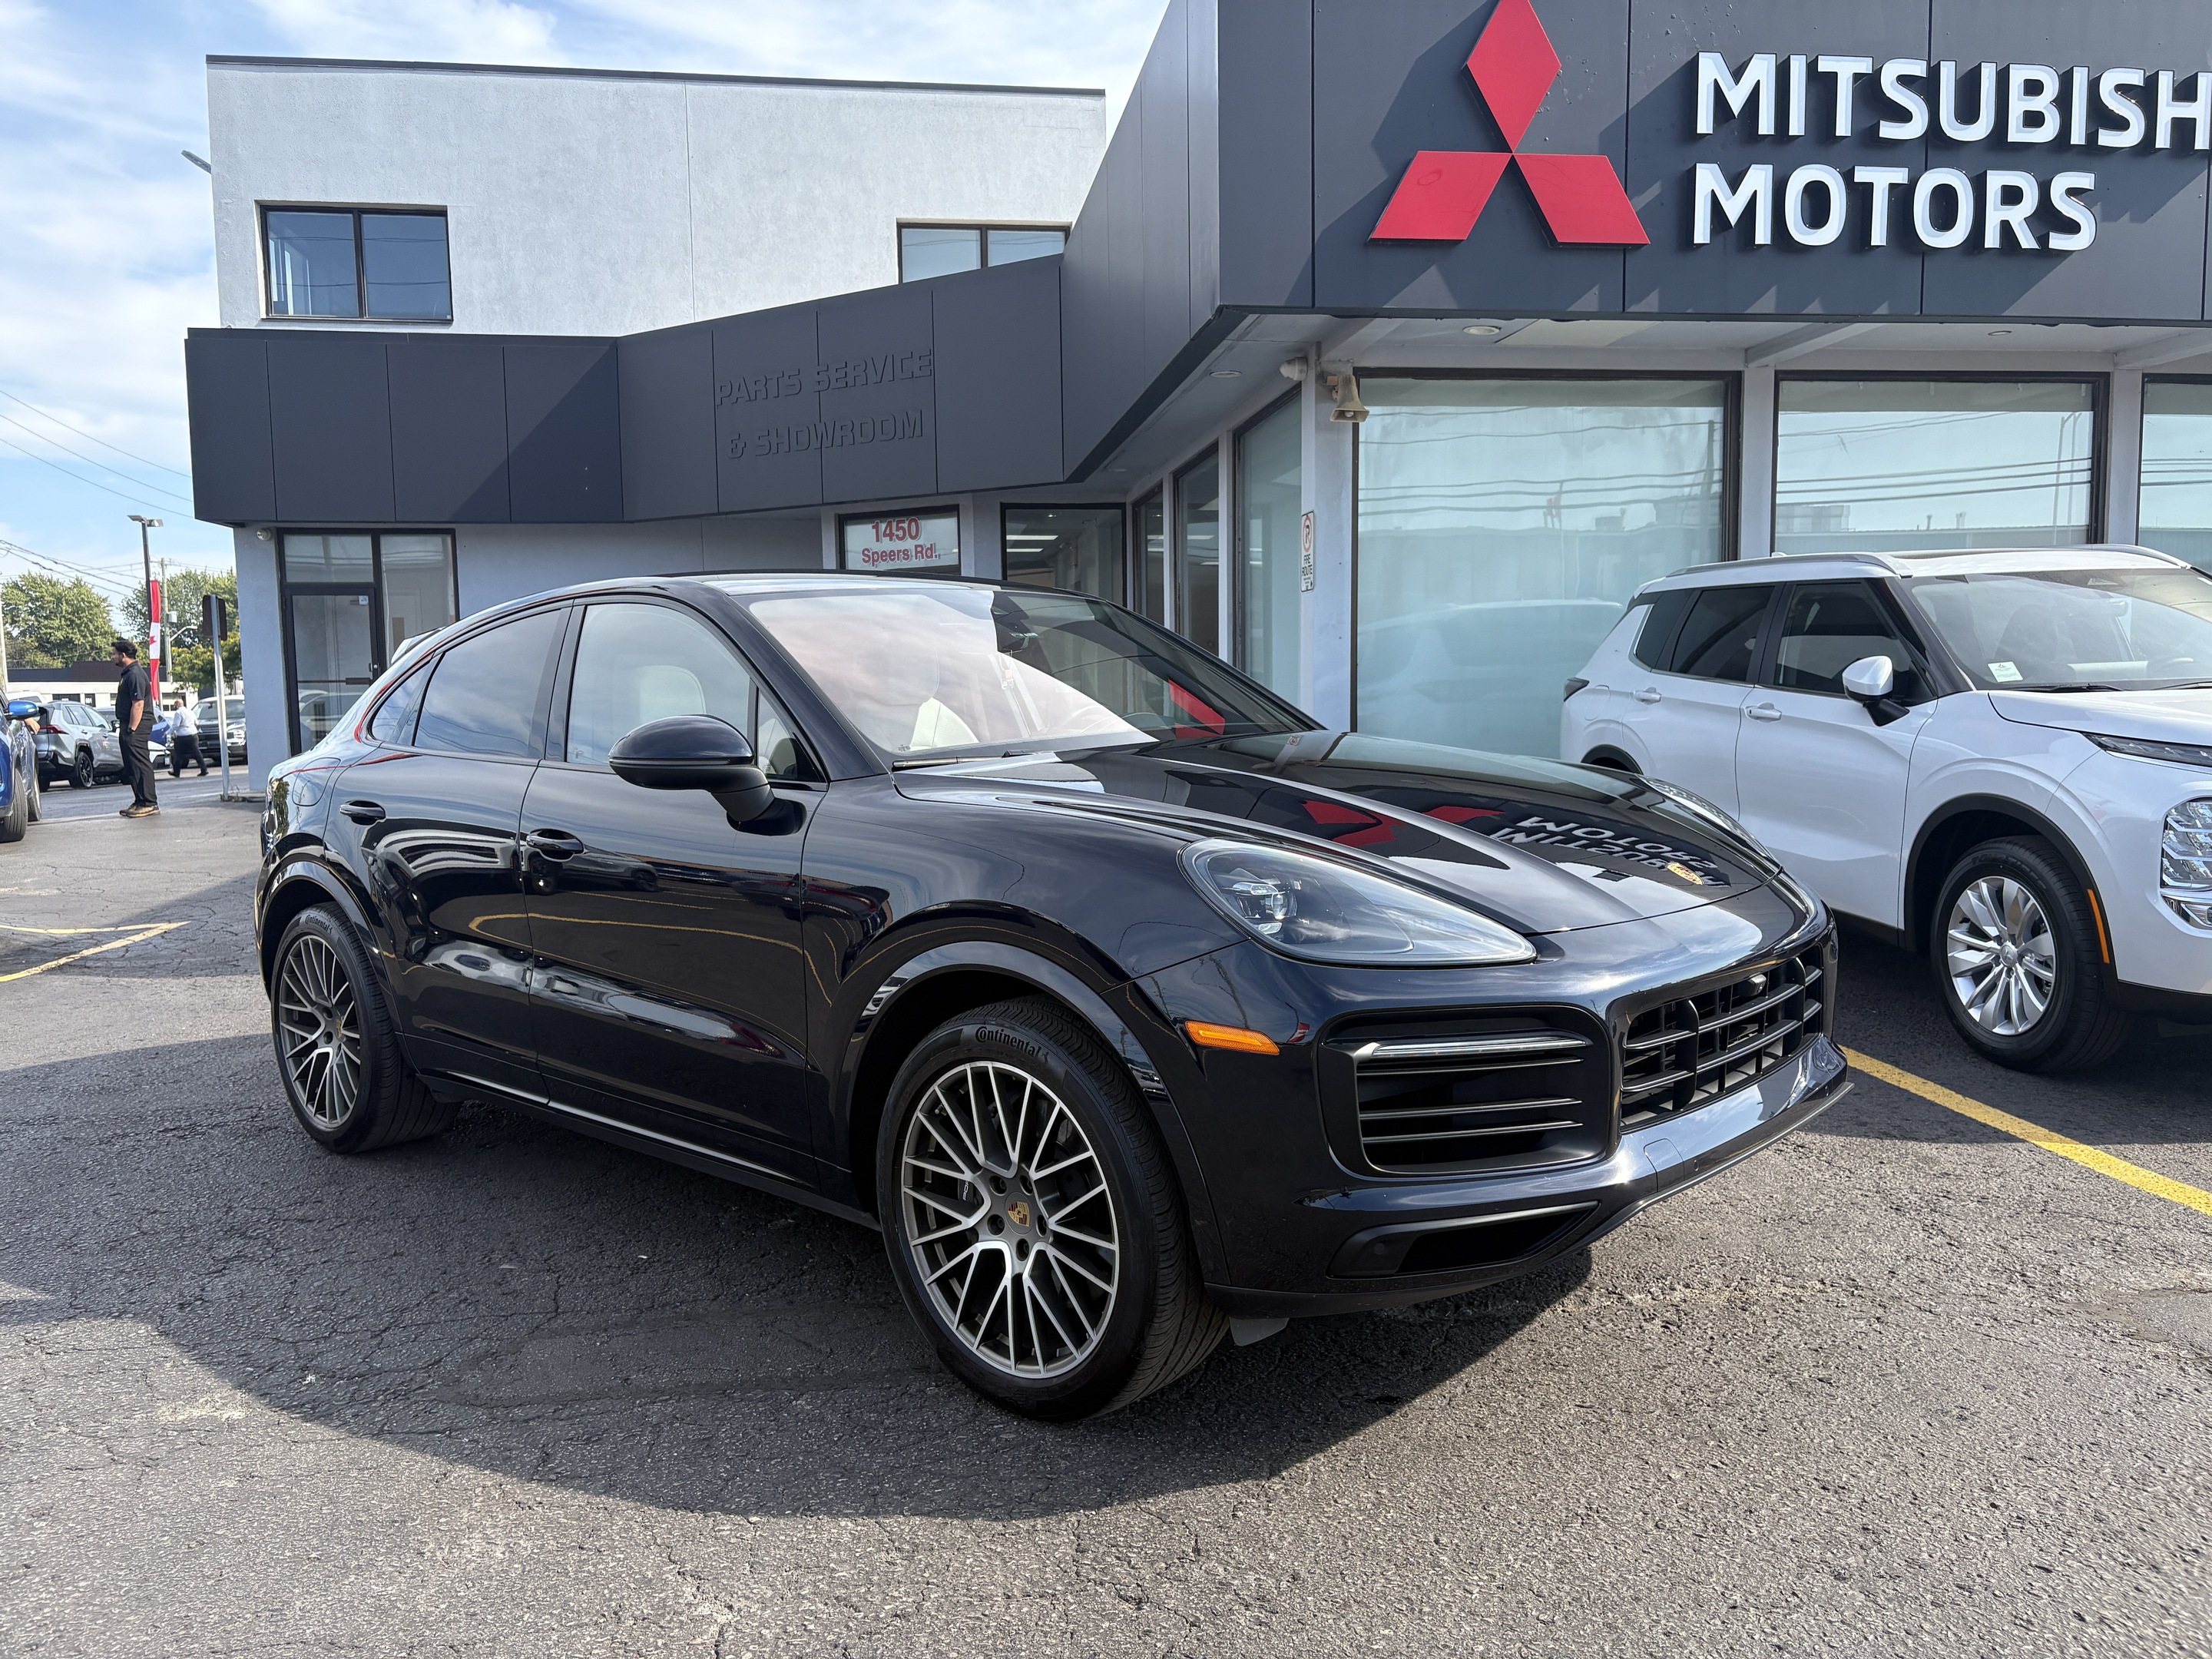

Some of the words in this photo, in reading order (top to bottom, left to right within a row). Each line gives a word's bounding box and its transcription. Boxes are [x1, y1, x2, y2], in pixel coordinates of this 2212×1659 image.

[1696, 51, 2212, 150] MITSUBISH
[1692, 162, 2098, 250] MOTORS
[716, 368, 802, 409] PARTS
[813, 349, 932, 393] SERVICE
[728, 432, 747, 459] &
[754, 409, 923, 456] SHOWROOM
[872, 518, 920, 542] 1450
[861, 548, 911, 568] Speers
[914, 542, 939, 561] Rd.
[305, 914, 329, 932] Continental
[975, 1025, 1041, 1058] Continental
